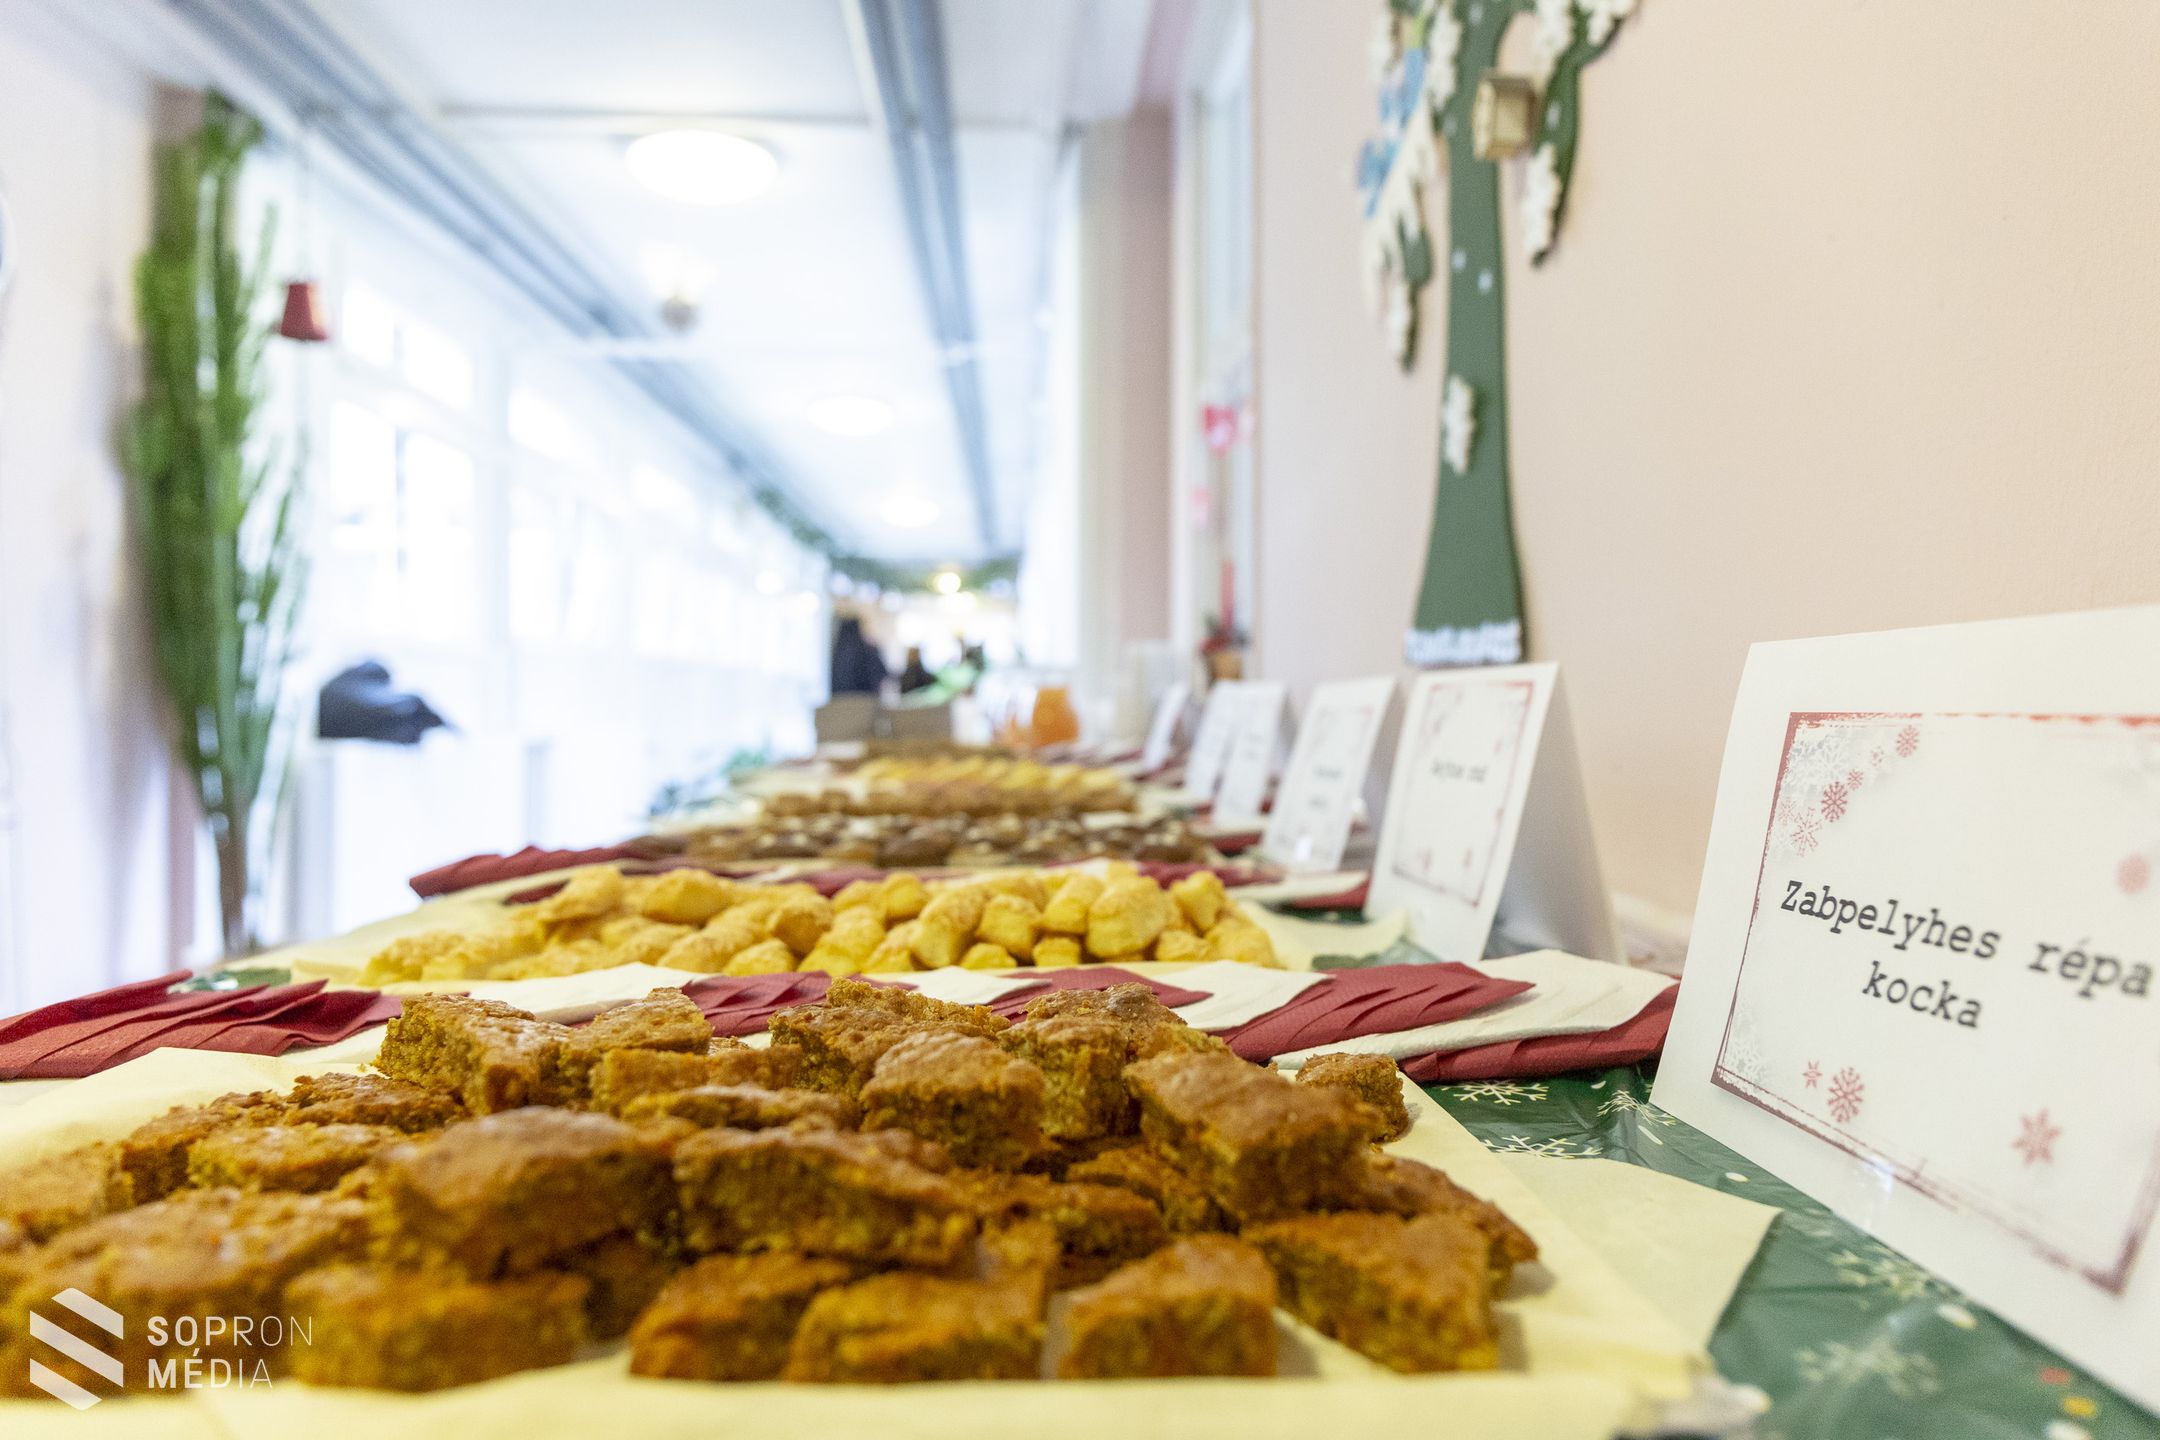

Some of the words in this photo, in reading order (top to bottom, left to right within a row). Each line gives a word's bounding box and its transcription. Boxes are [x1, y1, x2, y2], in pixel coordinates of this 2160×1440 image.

[1780, 880, 2002, 960] Zabpelyhes
[2027, 937, 2154, 1000] répa
[1862, 960, 1984, 1029] kocka
